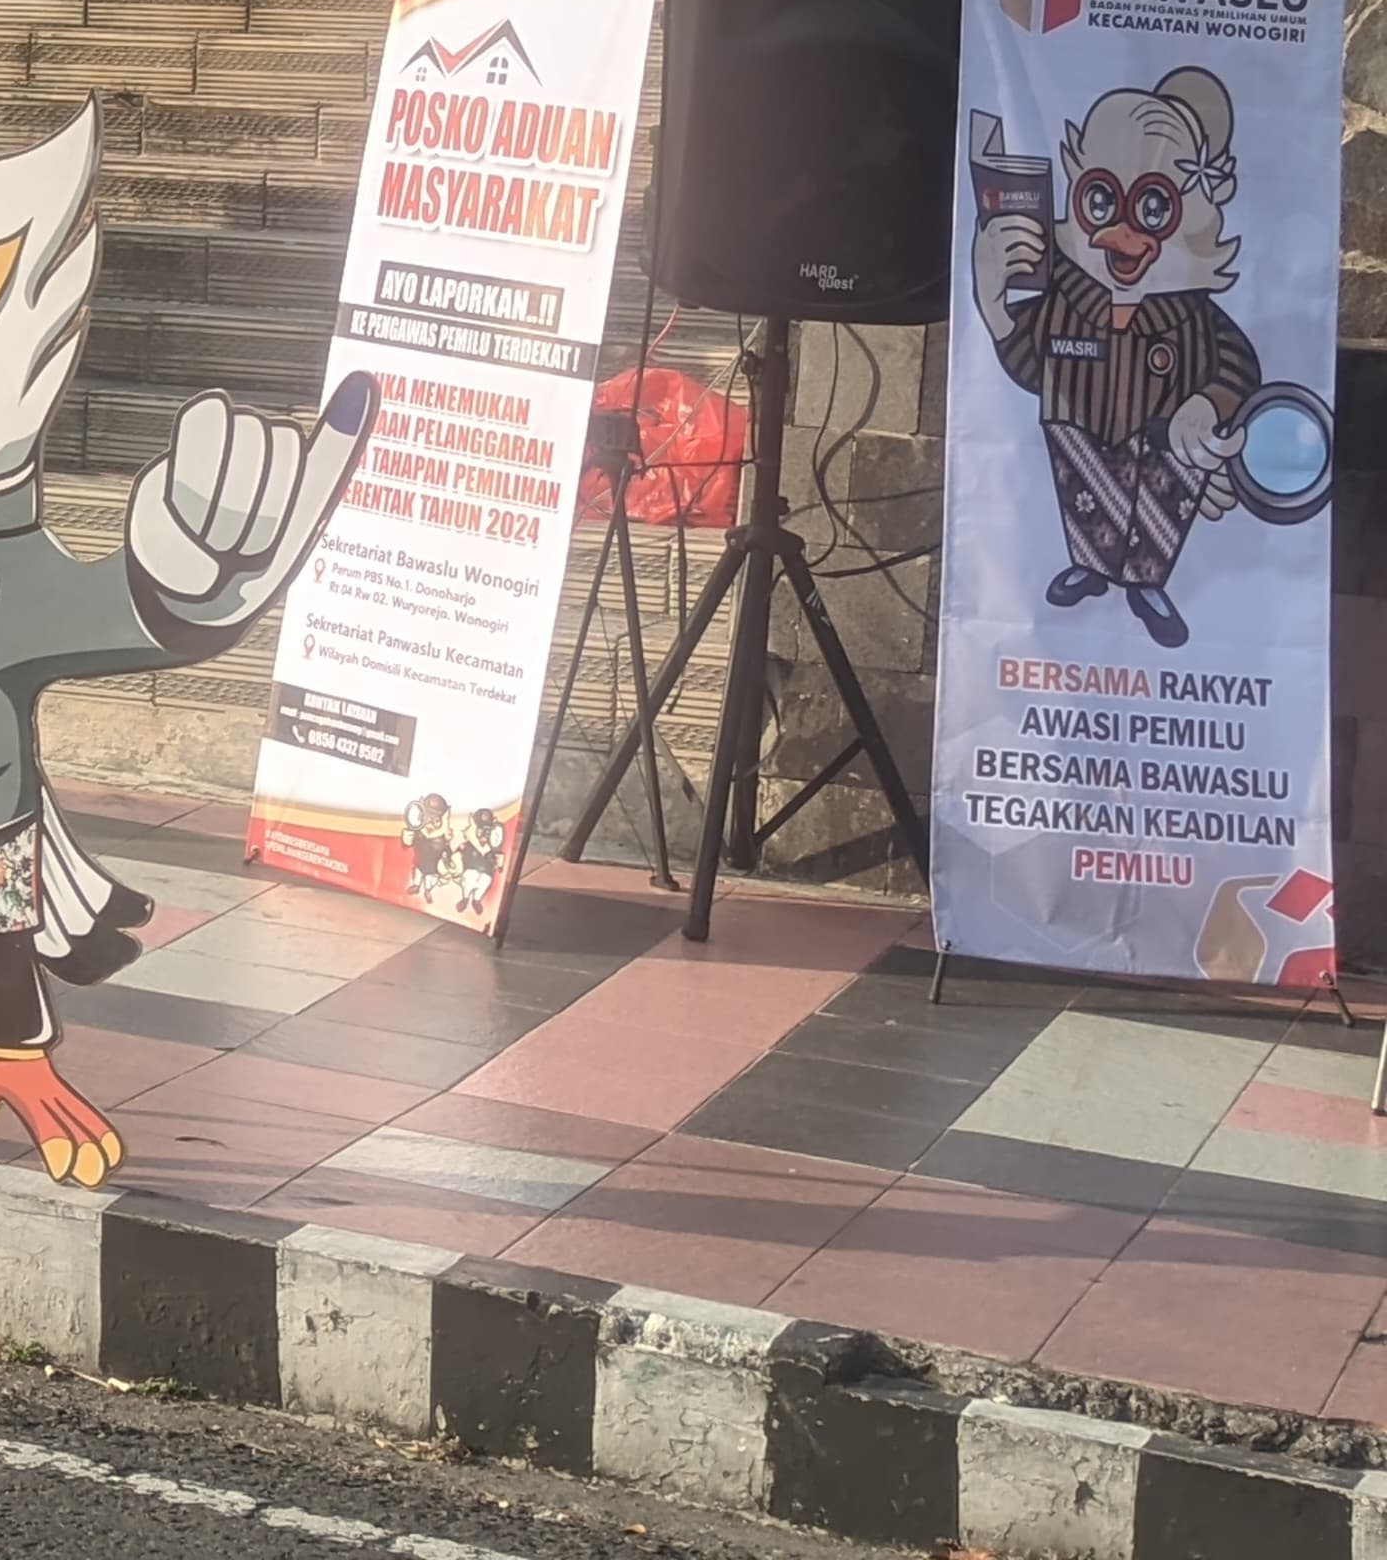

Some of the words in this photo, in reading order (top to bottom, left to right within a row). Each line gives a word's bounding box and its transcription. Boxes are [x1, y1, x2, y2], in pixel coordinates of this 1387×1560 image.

[1088, 12, 1199, 35] KECAMATAN
[1206, 22, 1306, 43] WONOGIRI
[1090, 0, 1131, 11] BADAN
[1134, 3, 1199, 17] PENGAWAS
[1202, 9, 1266, 22] PEMILIHAN
[1270, 14, 1307, 25] UMUM
[385, 88, 489, 155] POSKO
[490, 100, 617, 171] ADUAN
[377, 161, 600, 246] MASYARAKAT
[380, 269, 418, 303] AYO
[800, 264, 838, 278] HARD
[818, 277, 855, 291] quest
[350, 309, 366, 335] KE
[367, 313, 438, 347] PENGAWAS
[438, 323, 492, 357] PEMILU
[493, 333, 573, 371] TERDEKAT
[1051, 339, 1098, 357] WASRI
[410, 378, 531, 425] MENEMUKAN
[413, 415, 555, 469] PELANGGARAN
[372, 446, 449, 487] TAHAPAN
[452, 462, 561, 509] PEMILIHAN
[419, 493, 483, 532] TAHUN
[485, 508, 541, 544] 2024
[320, 533, 393, 565] Sekretariat
[396, 550, 459, 579] Bawaslu
[464, 564, 541, 598] Wonogiri
[364, 570, 384, 584] PBS
[415, 582, 477, 607] Donoharjo
[355, 586, 371, 600] Rw
[454, 610, 510, 633] Wonogiri
[306, 612, 373, 643] Sekretariat
[377, 630, 441, 659] Panwaslu
[444, 646, 524, 680] Kecamatan
[318, 644, 359, 665] Wilayah
[361, 656, 402, 676] Domisili
[403, 667, 467, 693] Kecamatan
[469, 682, 517, 705] Terdekat
[998, 658, 1150, 698] BERSAMA
[1159, 671, 1272, 707] RAKYAT
[1021, 707, 1120, 742] AWASI
[1129, 716, 1245, 750] PEMILU
[976, 749, 1131, 788] BERSAMA
[1141, 761, 1289, 799] BAWASLU
[965, 793, 1134, 835] TEGAKKAN
[1143, 808, 1296, 846] KEADILAN
[1074, 849, 1193, 886] PEMILU
